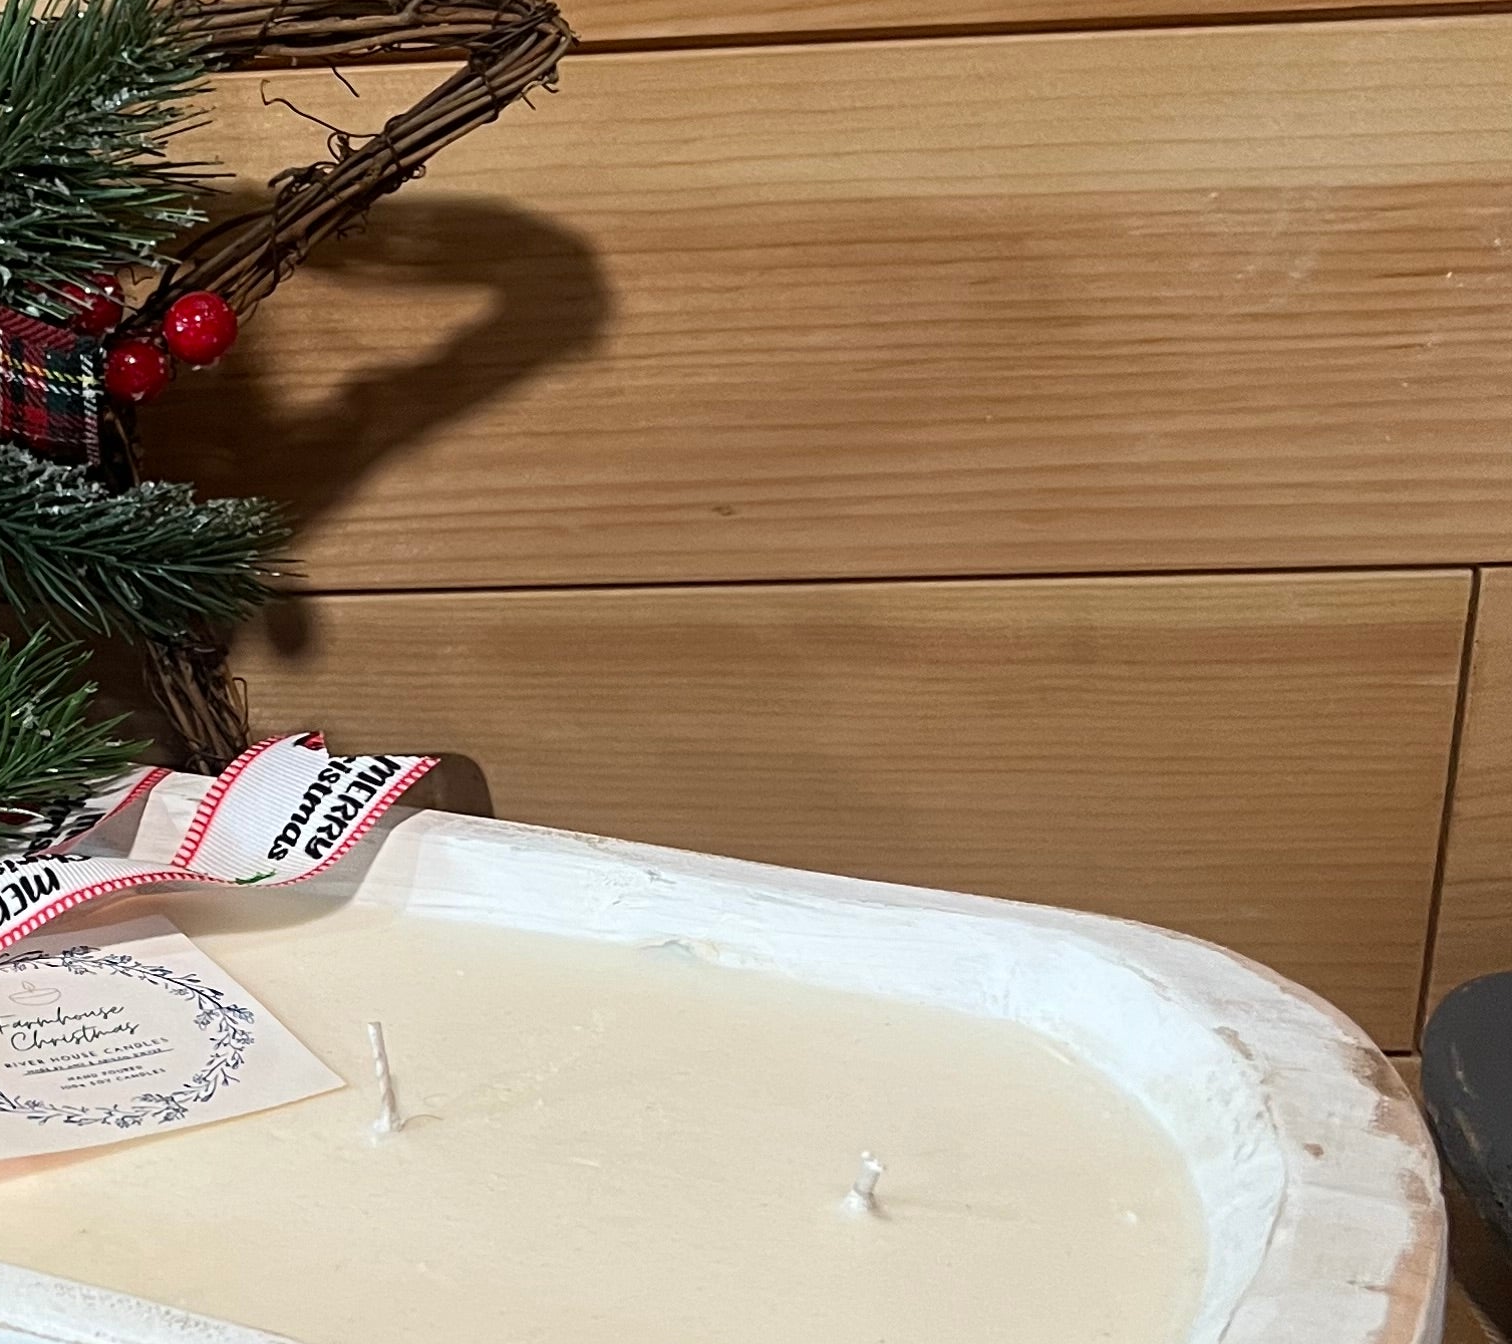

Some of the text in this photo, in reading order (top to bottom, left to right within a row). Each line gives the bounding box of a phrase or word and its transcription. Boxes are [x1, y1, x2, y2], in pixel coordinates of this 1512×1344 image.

[305, 756, 401, 859] MERRY
[11, 1022, 140, 1051] Christmas
[4, 1058, 46, 1069] RIVER
[50, 1050, 96, 1063] HOUSE
[103, 1037, 169, 1055] CANDLES
